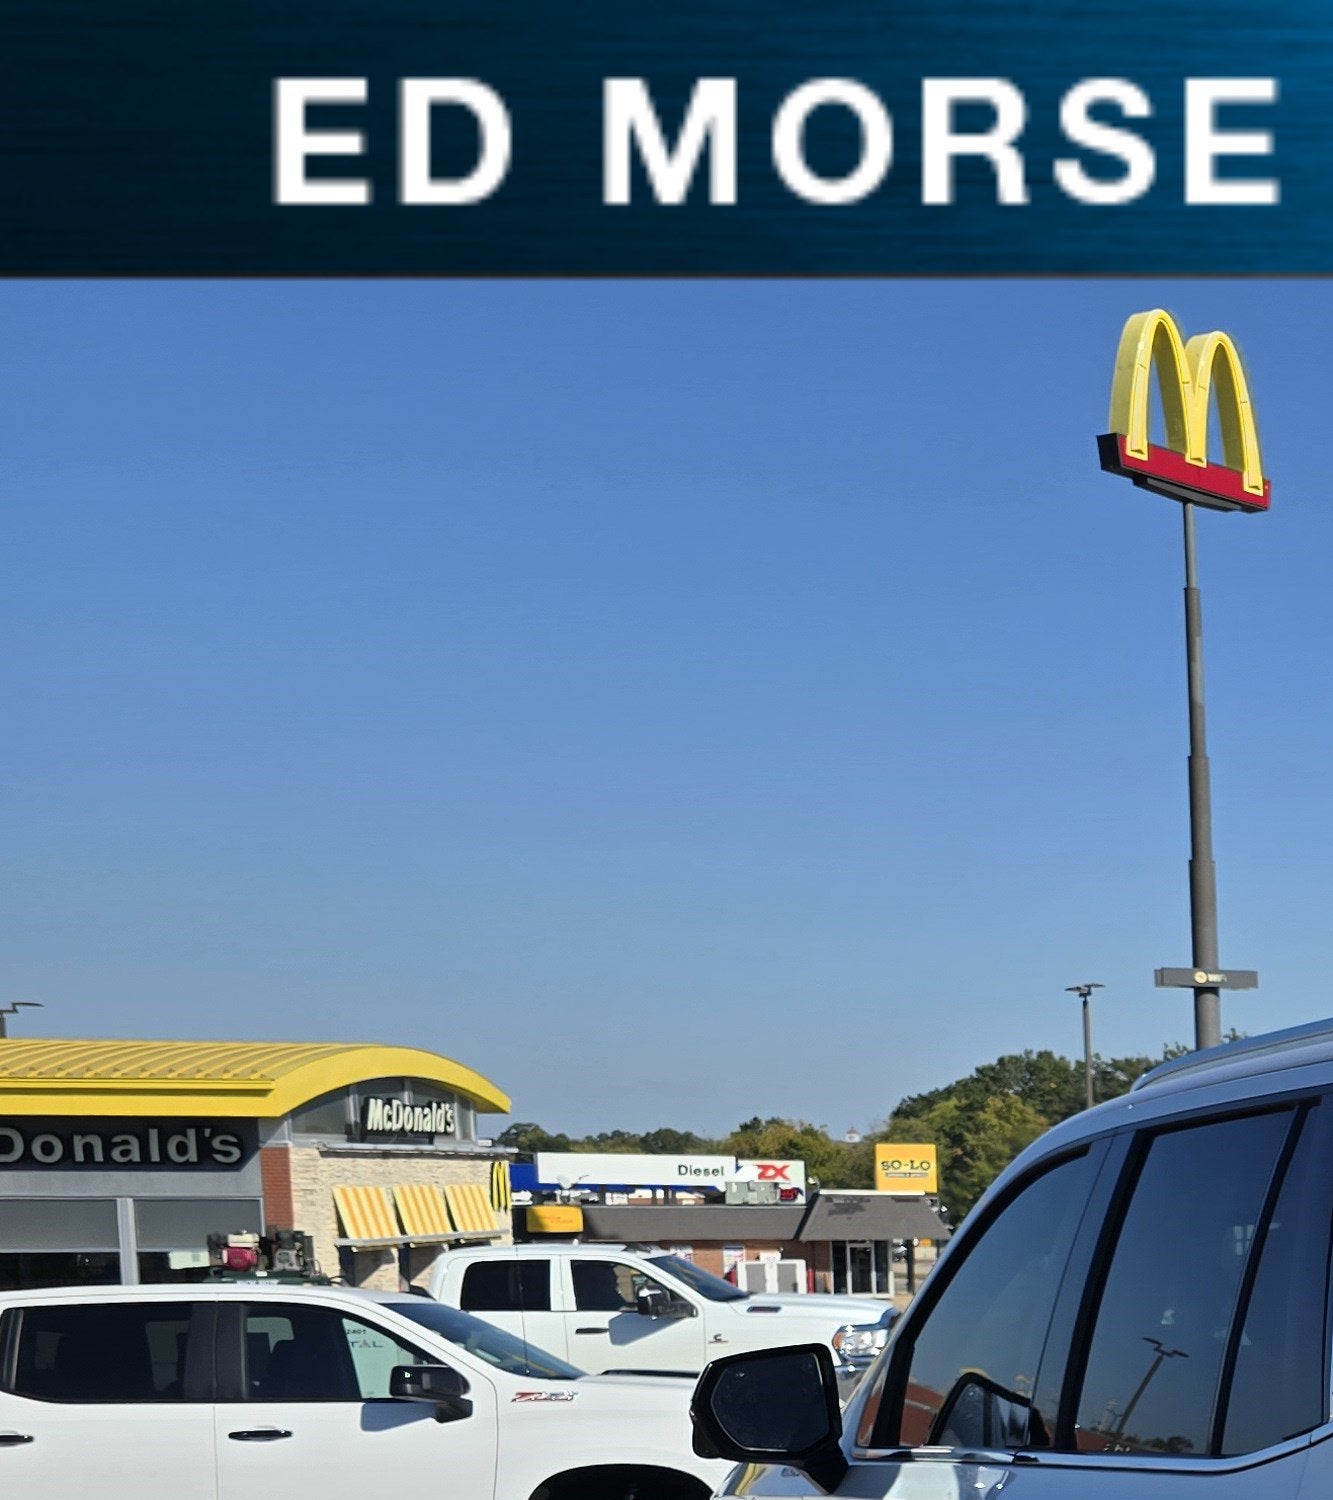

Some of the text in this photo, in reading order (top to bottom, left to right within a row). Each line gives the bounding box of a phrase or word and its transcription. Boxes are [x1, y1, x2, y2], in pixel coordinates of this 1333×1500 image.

[366, 1098, 455, 1133] McDonald's
[678, 1164, 725, 1177] Diesel
[881, 1160, 930, 1171] SO-LO
